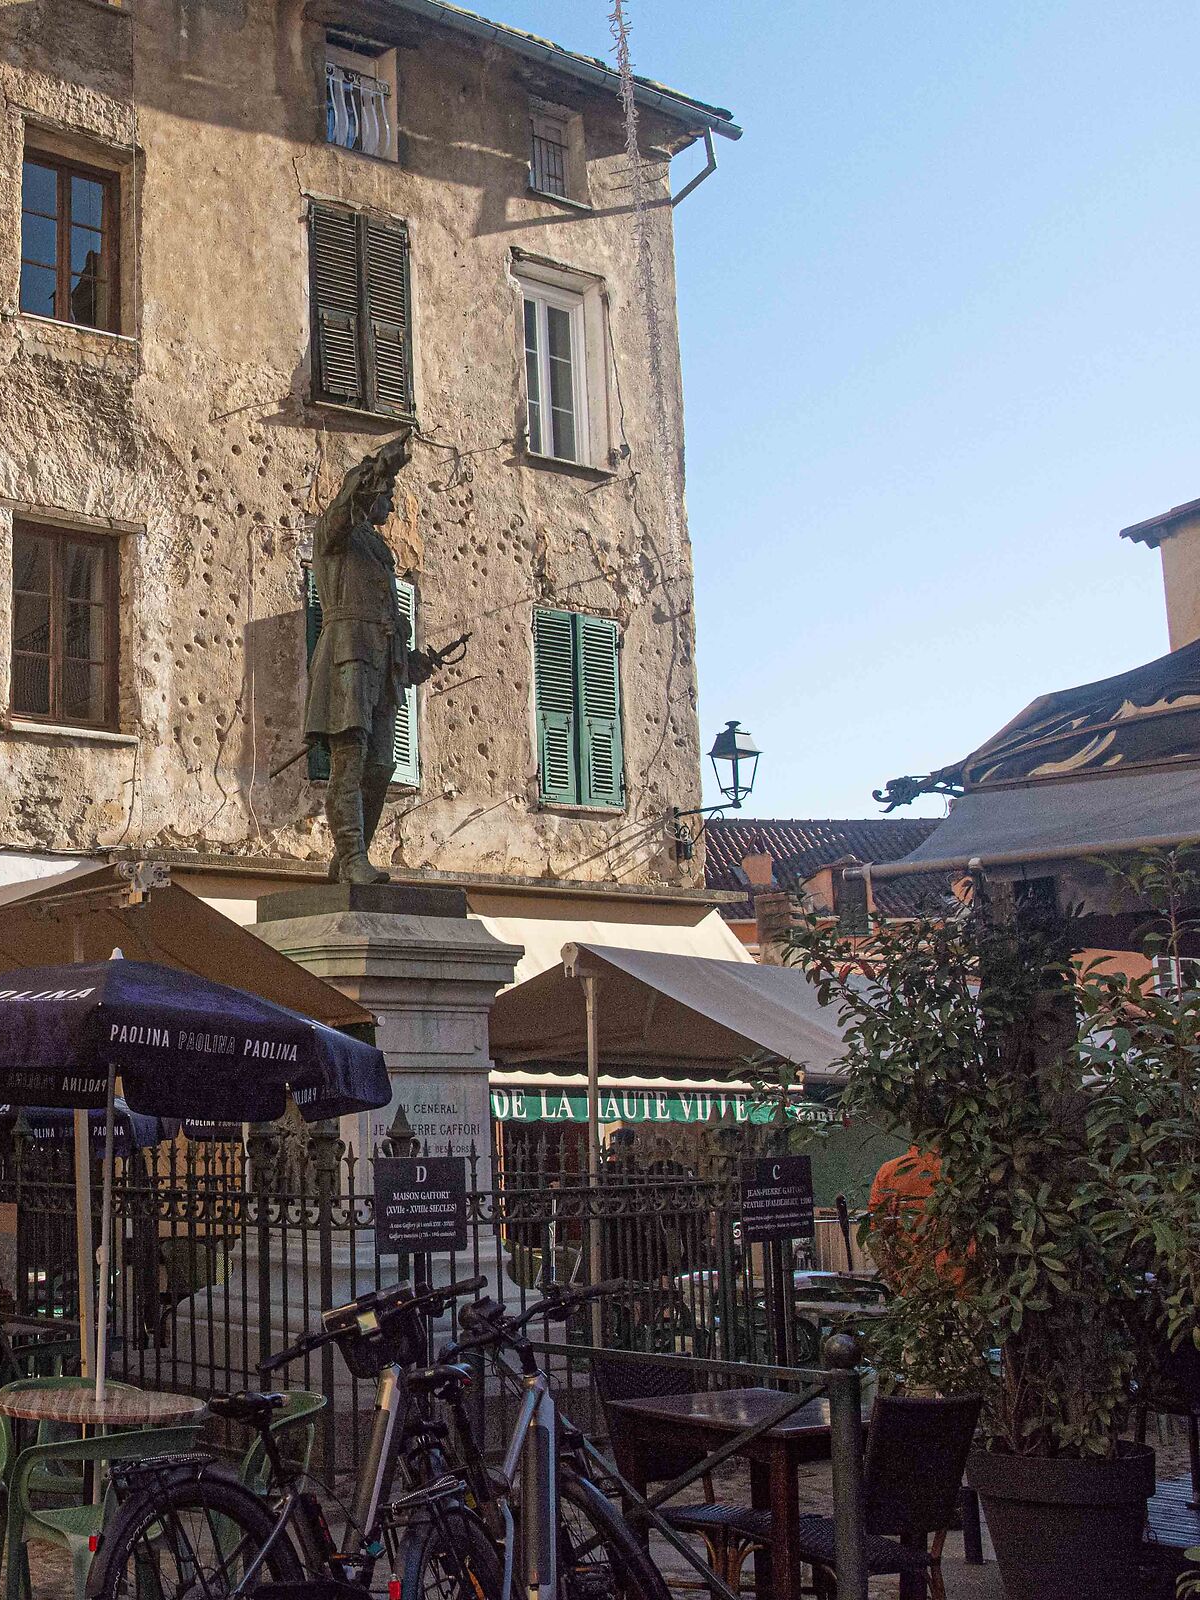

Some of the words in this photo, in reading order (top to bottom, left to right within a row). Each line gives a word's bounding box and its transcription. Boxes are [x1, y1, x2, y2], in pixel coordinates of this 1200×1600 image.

[109, 1023, 171, 1048] PAOLINA
[177, 1030, 236, 1055] PAOLINA
[243, 1038, 299, 1062] PAOLINA
[489, 1088, 528, 1119] DE
[540, 1089, 575, 1119] LA
[440, 1123, 480, 1136] GAFFORI
[415, 1165, 428, 1183] D
[772, 1164, 781, 1181] C
[392, 1191, 420, 1201] MAISON
[420, 1190, 451, 1201] GAFFORY
